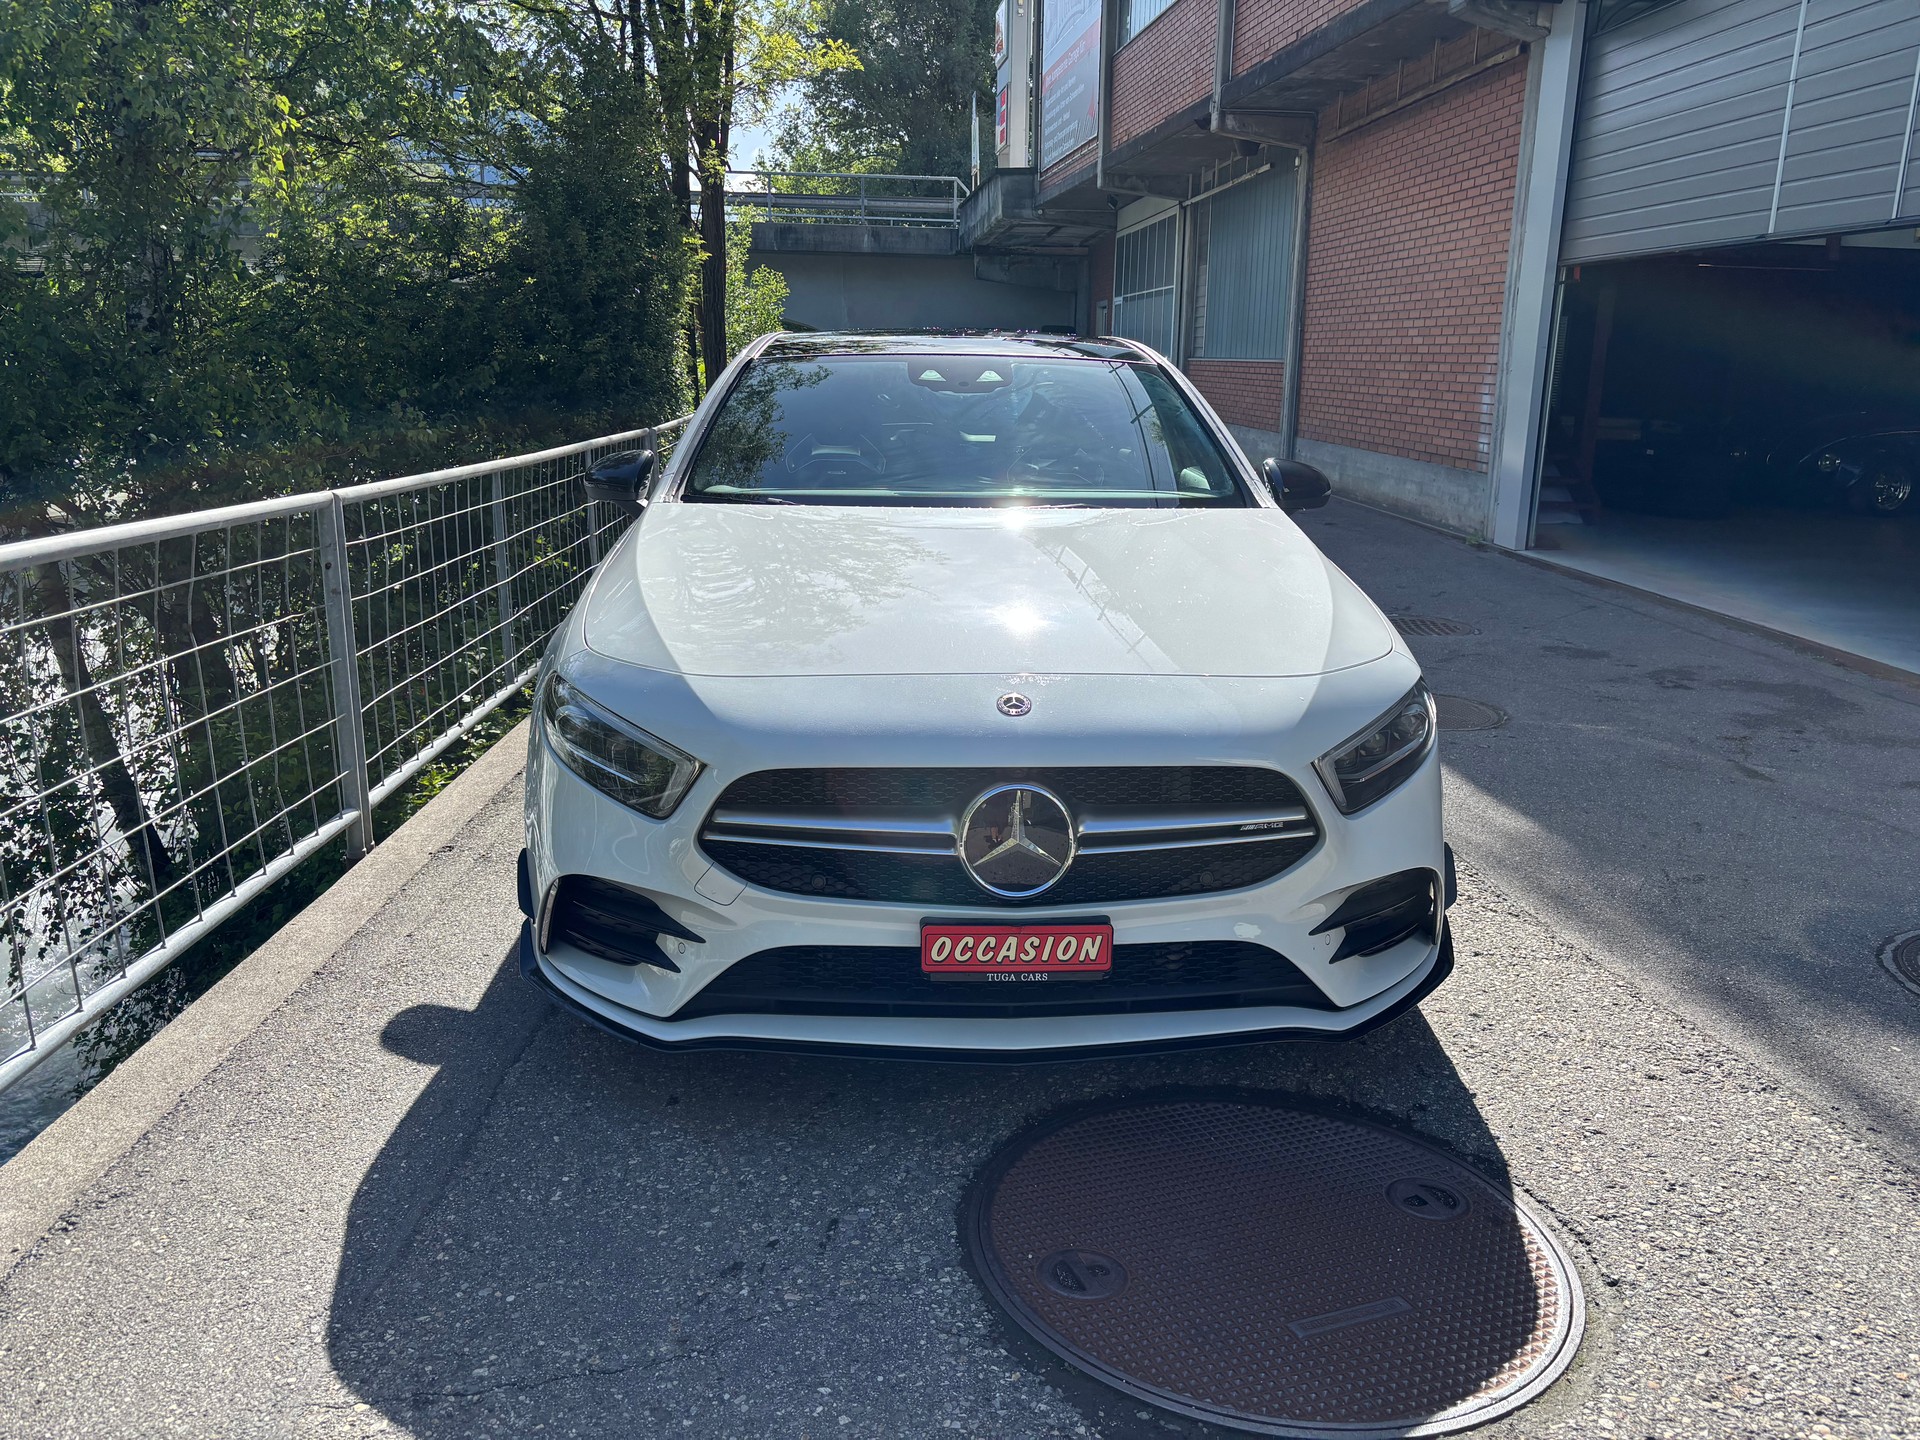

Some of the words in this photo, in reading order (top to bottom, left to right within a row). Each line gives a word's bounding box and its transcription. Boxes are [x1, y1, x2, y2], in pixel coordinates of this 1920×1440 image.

[930, 935, 1103, 963] OCCASION
[986, 973, 1016, 981] TUGA
[1020, 973, 1048, 981] CARS
